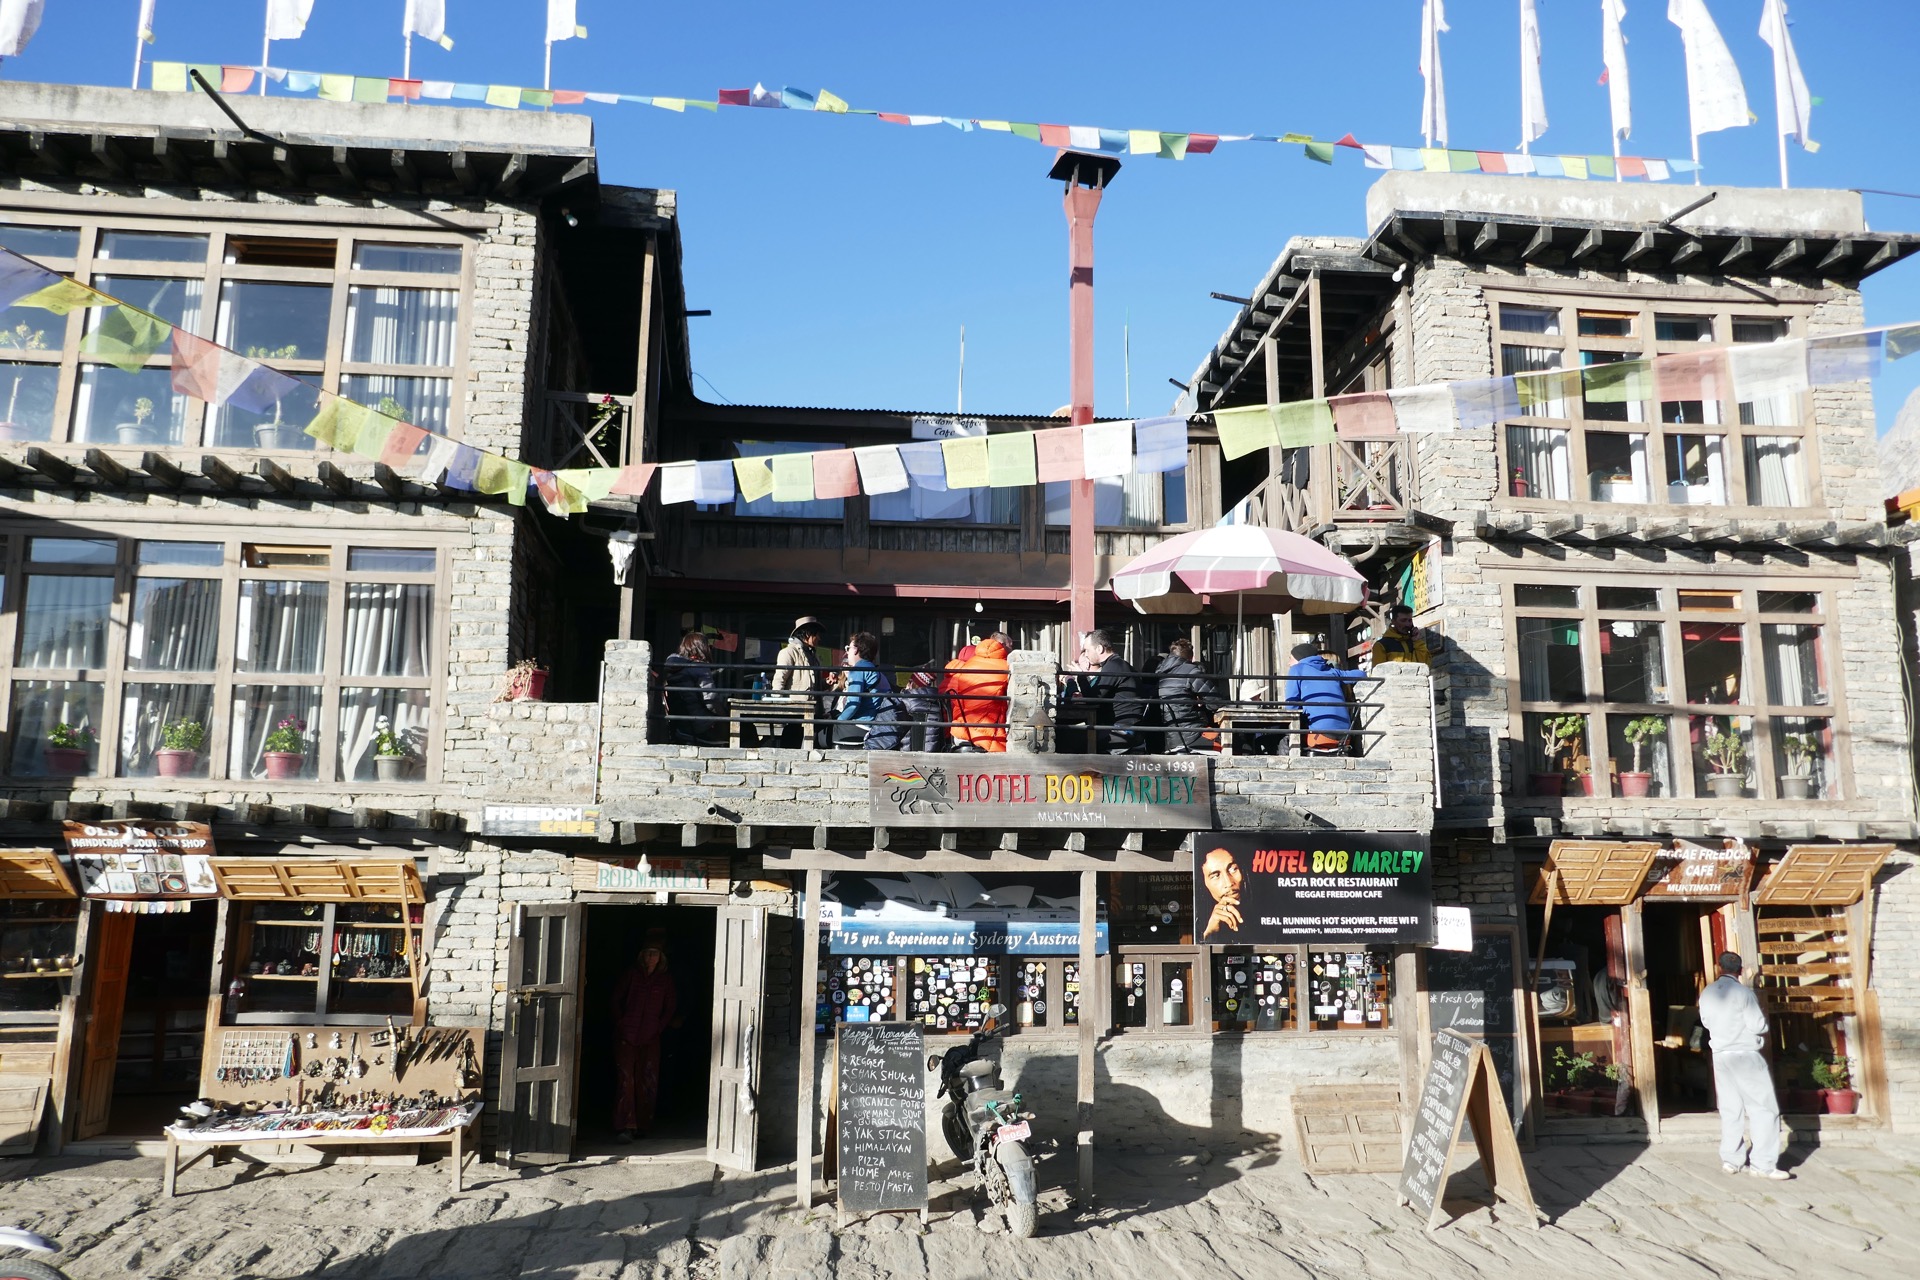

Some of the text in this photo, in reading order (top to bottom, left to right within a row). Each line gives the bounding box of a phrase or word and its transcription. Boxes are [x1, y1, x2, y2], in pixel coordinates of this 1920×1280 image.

[934, 427, 956, 438] Cafe
[1126, 759, 1196, 773] Since 1989
[957, 774, 1198, 805] HOTEL BOB MARLEY
[485, 806, 583, 821] FREEDOM
[1037, 812, 1103, 823] MUKTINATH
[83, 826, 119, 837] OLD
[154, 826, 189, 838] OLD
[540, 820, 596, 834] CAFE
[181, 840, 207, 848] SHOP
[1252, 849, 1424, 875] HOTEL BOB MARLEY
[1685, 862, 1715, 877] CAFÉ
[599, 868, 706, 889] BOB MARLEY
[1277, 877, 1399, 888] RASTA ROCK RESTAURANT
[1295, 890, 1383, 898] REGGAE FREEDOM CAFE
[1667, 883, 1722, 892] MUKTINATH
[1260, 917, 1282, 926] REAL
[1283, 917, 1321, 925] RUNNING
[1322, 917, 1340, 925] HOT
[1340, 917, 1377, 926] SHOWER,
[1378, 917, 1399, 925] FREE
[862, 934, 882, 948] yrs.
[887, 930, 949, 948] Experience
[952, 932, 965, 945] in
[967, 930, 1022, 950] Sydeny
[1440, 991, 1463, 1004] Fresh
[851, 1068, 916, 1084] SHAK SHUKA
[849, 1081, 924, 1100] ORGANIC SALAD
[851, 1096, 897, 1108] ORGANIC
[854, 1126, 911, 1141] YAK STICK
[854, 1142, 912, 1154] HIMALAYAN
[858, 1155, 886, 1168] PIZZA
[851, 1165, 913, 1180] HOME MADE
